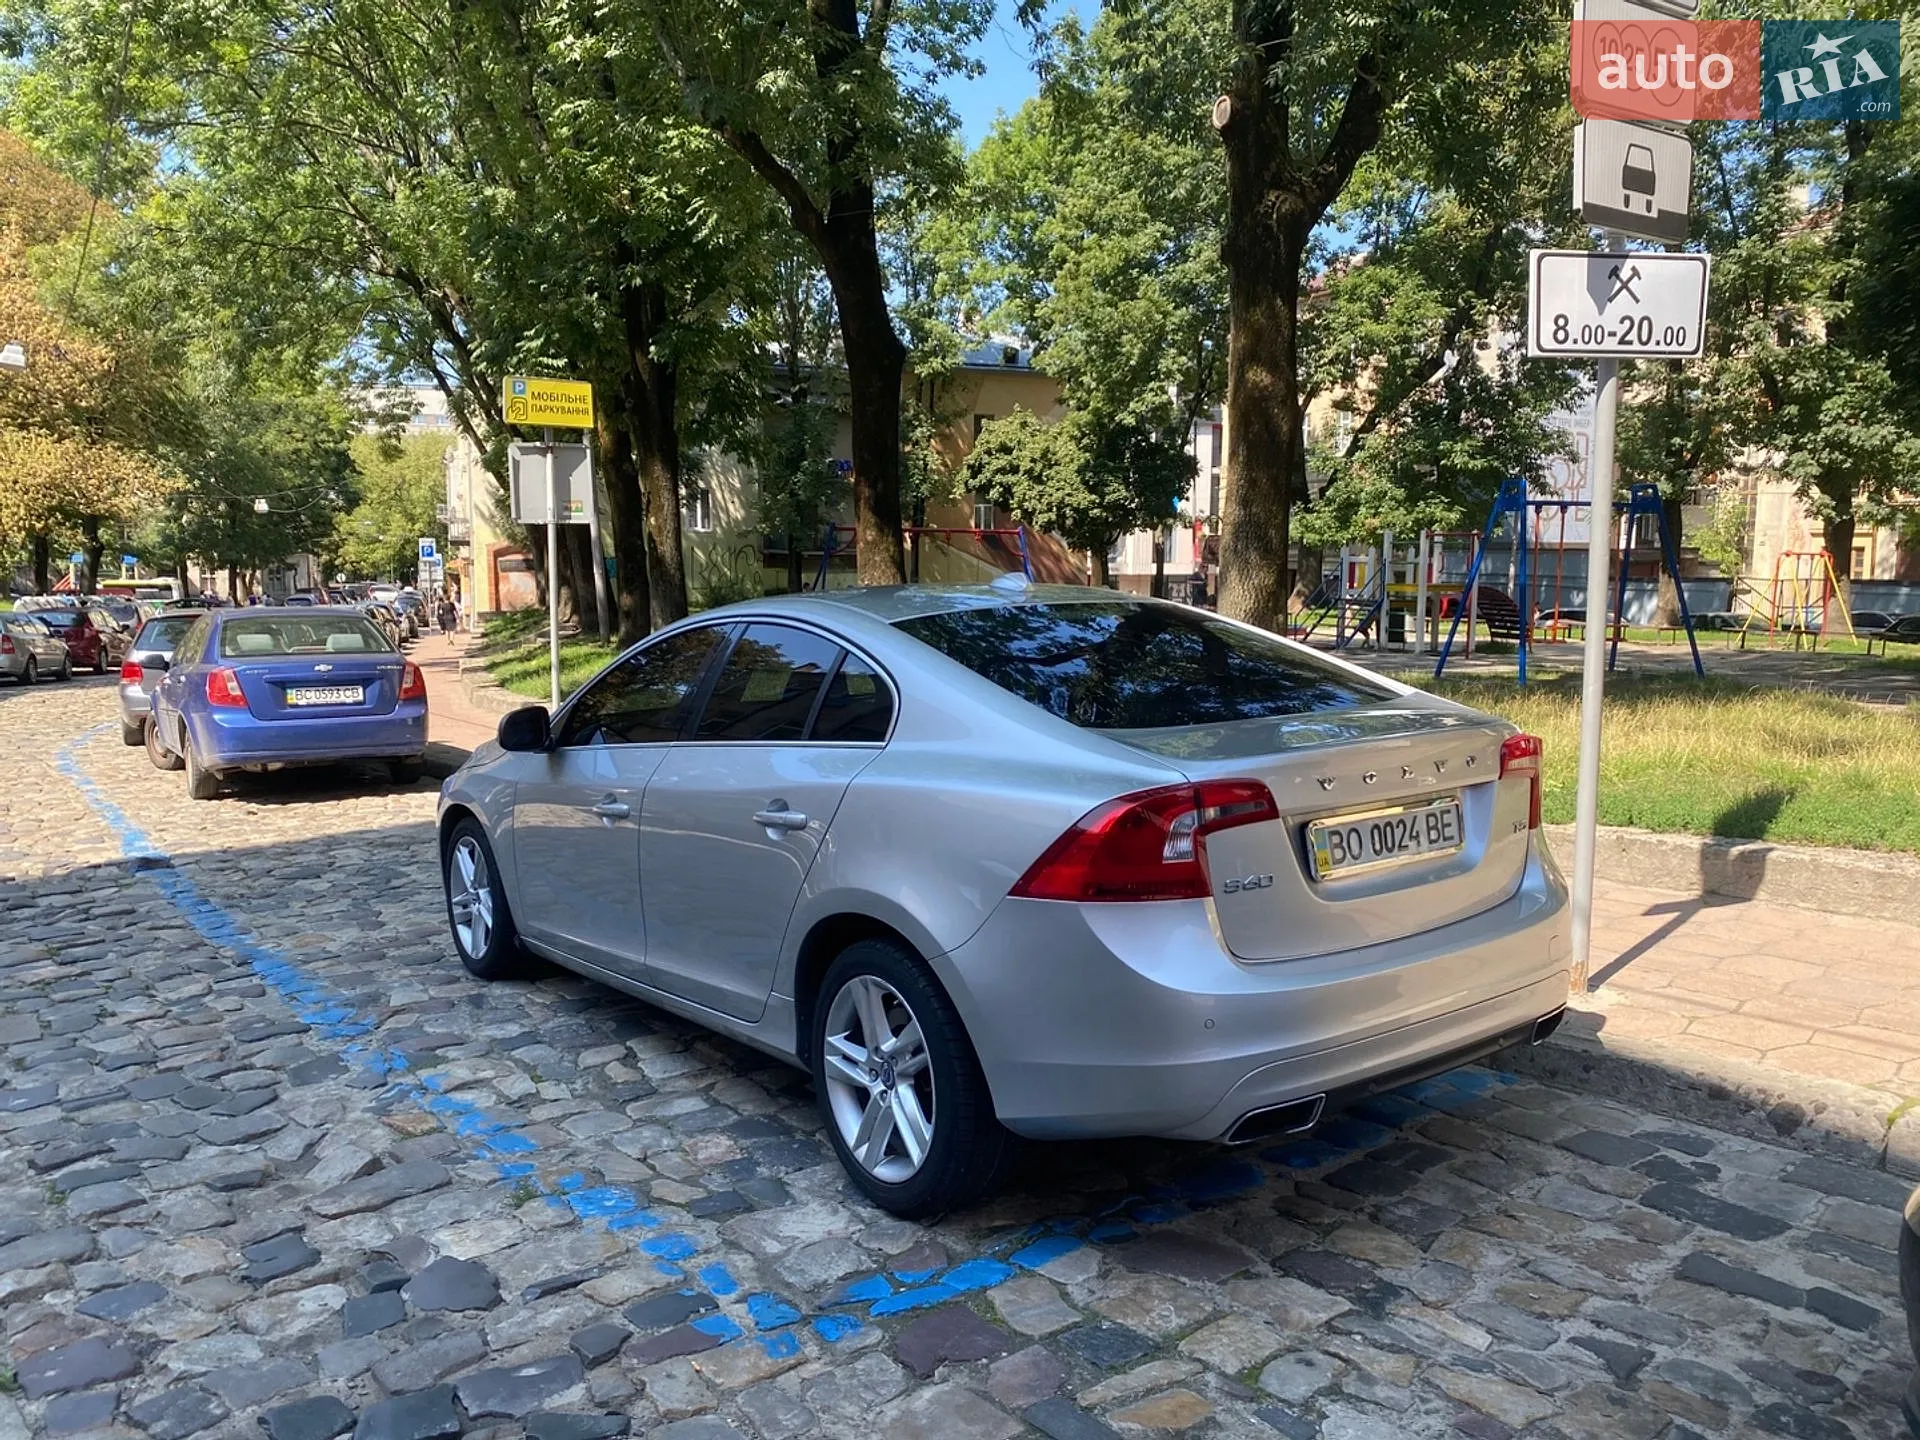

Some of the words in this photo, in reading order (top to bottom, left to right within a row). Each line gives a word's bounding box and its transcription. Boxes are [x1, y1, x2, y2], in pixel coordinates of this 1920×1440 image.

[1552, 313, 1687, 347] 8.00-20.00
[531, 391, 588, 404] МОБІЛЬНЕ
[531, 404, 590, 416] ПАРКУВАННЯ
[314, 688, 341, 700] 0593
[1317, 754, 1477, 791] VOLVO
[1327, 828, 1363, 866] BO
[1370, 814, 1422, 857] 0024
[1425, 809, 1455, 844] BE
[1223, 872, 1275, 894] S60
